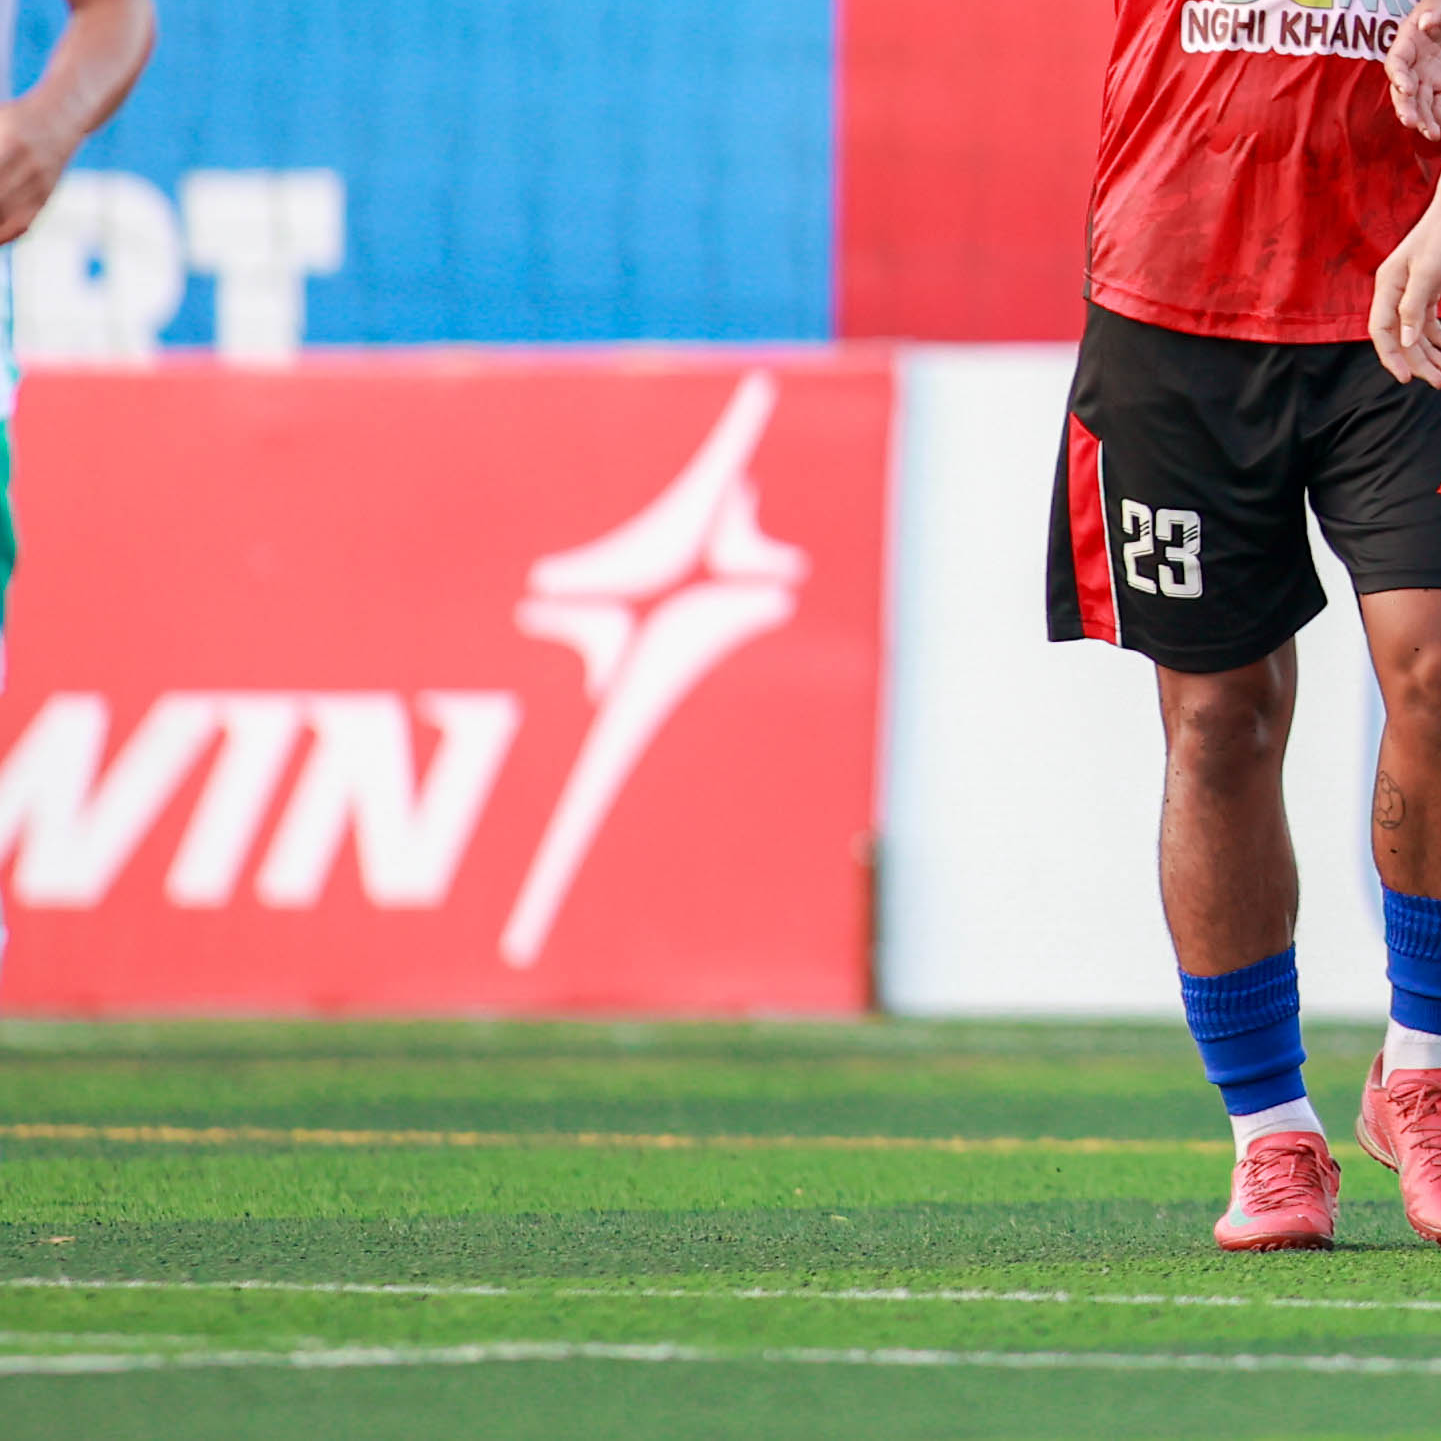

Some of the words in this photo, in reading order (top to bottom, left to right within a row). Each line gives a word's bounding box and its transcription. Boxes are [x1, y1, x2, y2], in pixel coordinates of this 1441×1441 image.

[1187, 8, 1267, 44] NGHI
[1279, 10, 1399, 54] KHANG
[1121, 497, 1204, 600] 23
